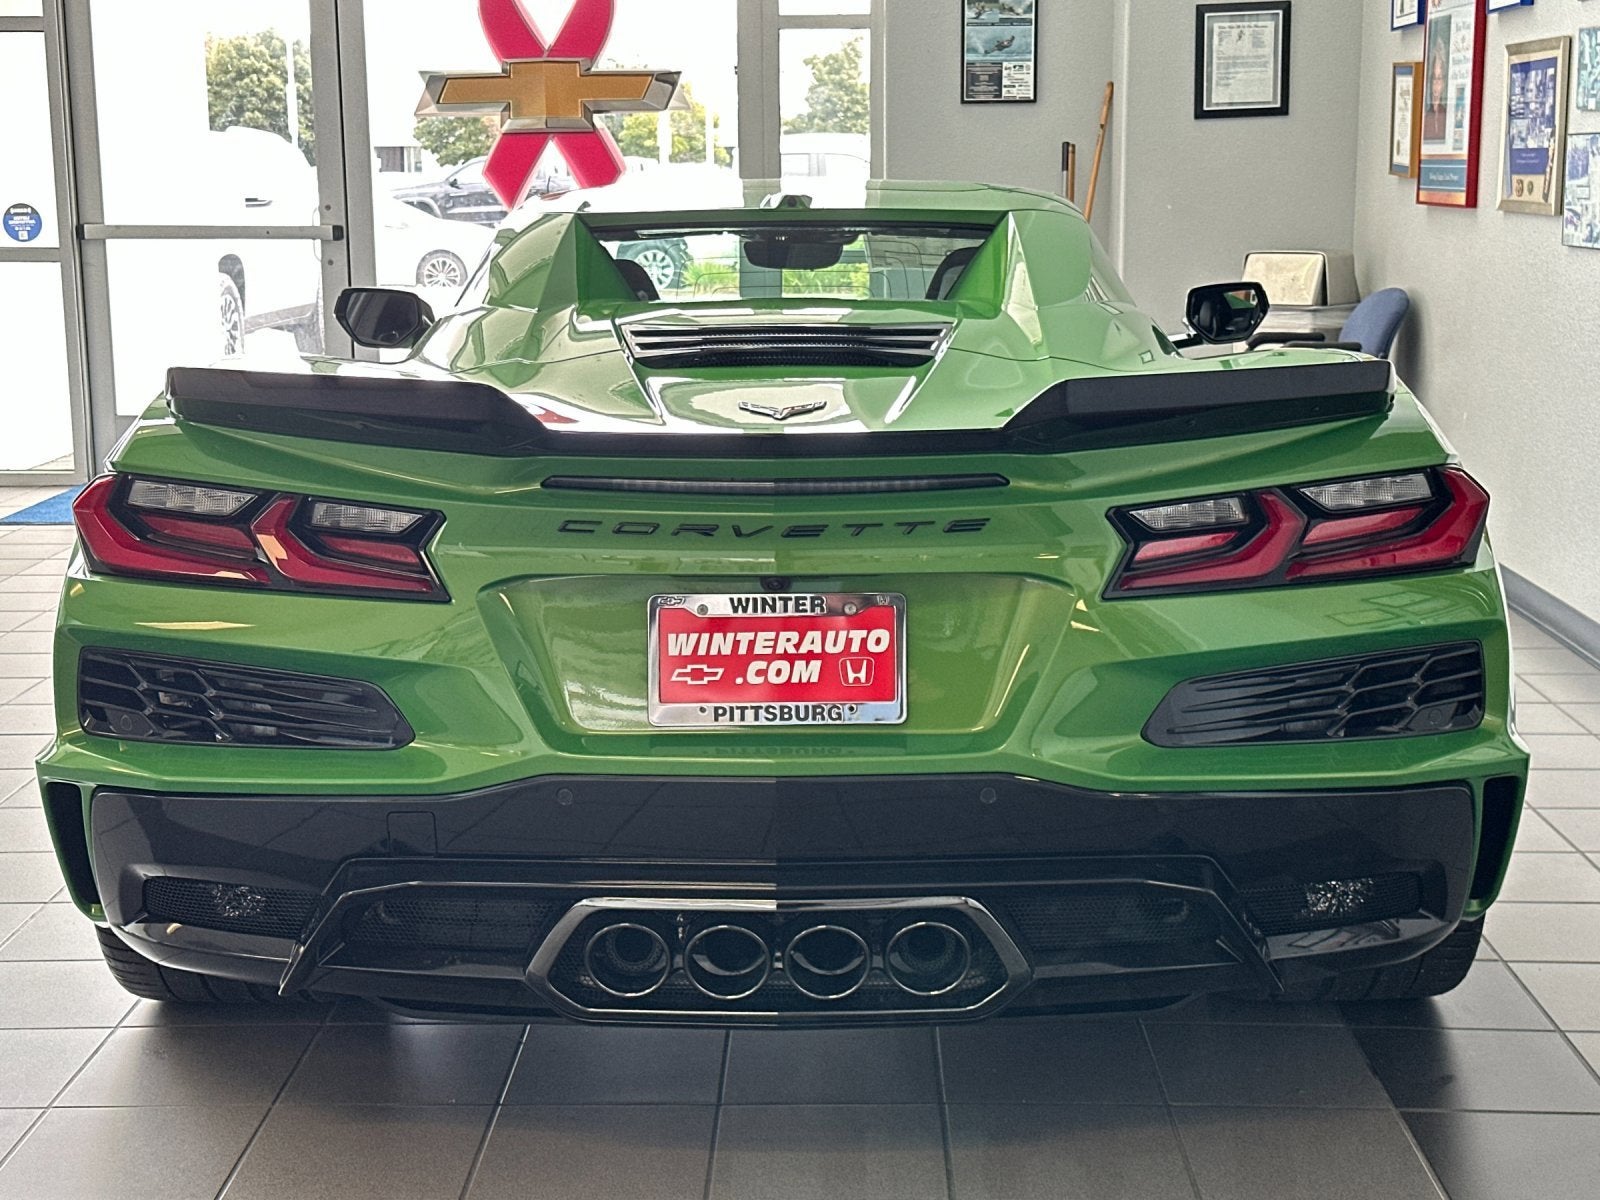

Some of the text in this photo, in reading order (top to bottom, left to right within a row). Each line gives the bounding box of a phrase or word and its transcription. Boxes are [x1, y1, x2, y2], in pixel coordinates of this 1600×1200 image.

[557, 517, 991, 539] CORVETTE
[729, 595, 827, 615] WINTER
[667, 629, 890, 656] WINTERAUTO
[735, 659, 822, 685] .COM
[713, 704, 844, 723] PITTSBURG
